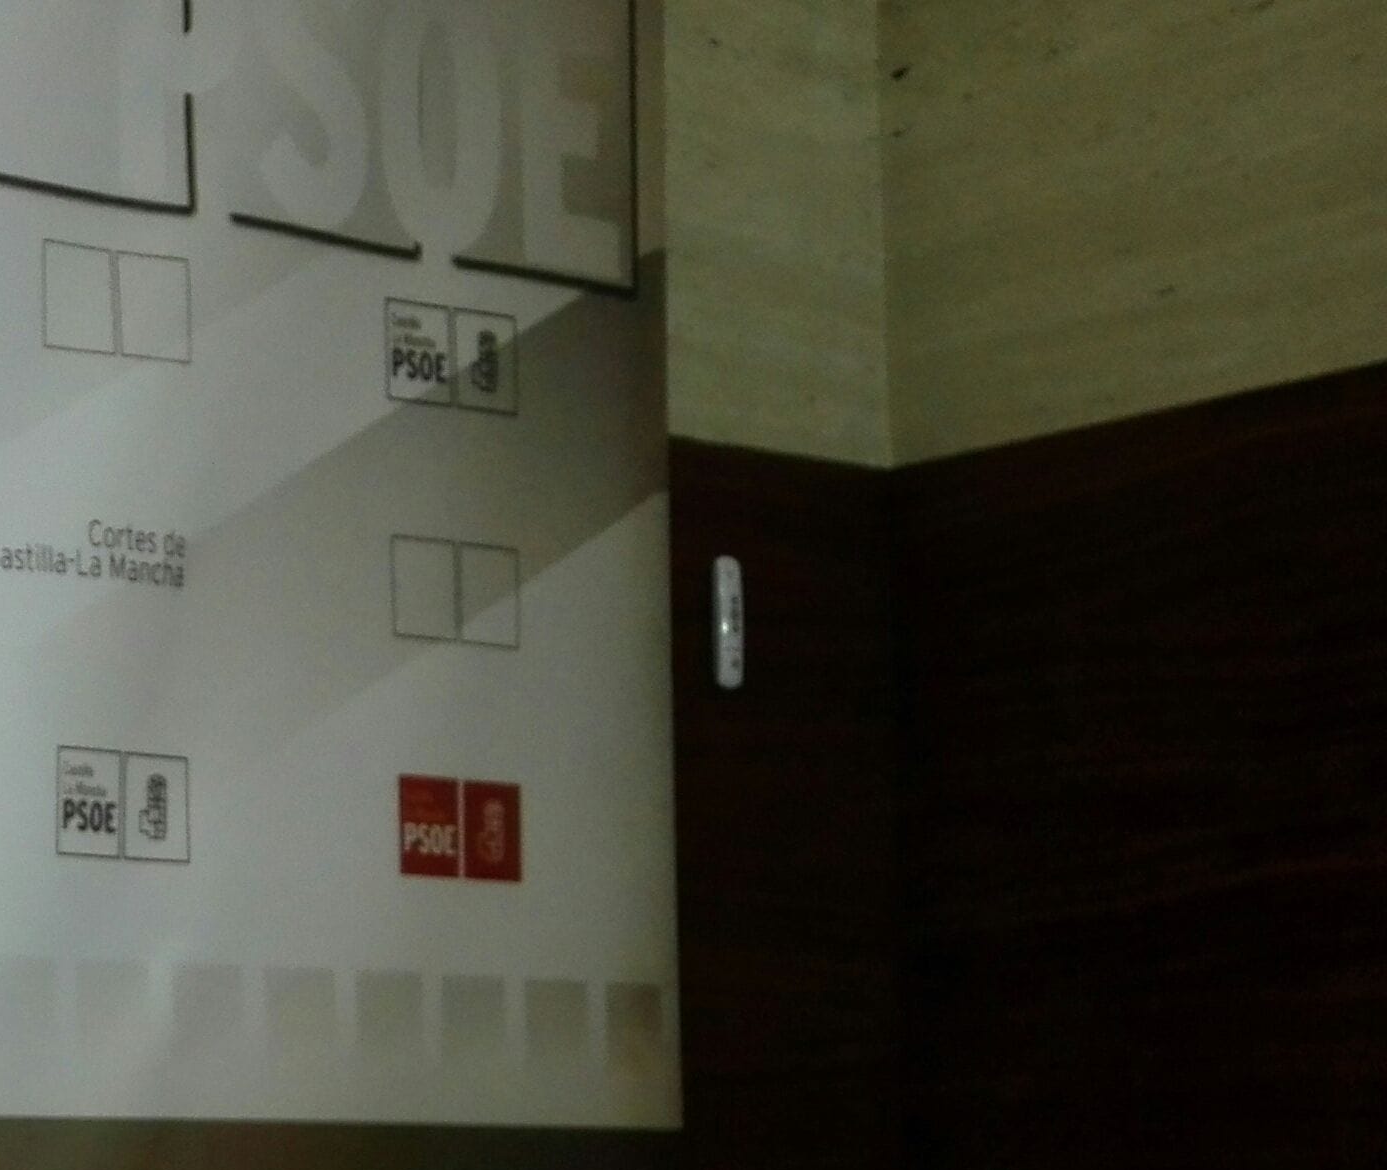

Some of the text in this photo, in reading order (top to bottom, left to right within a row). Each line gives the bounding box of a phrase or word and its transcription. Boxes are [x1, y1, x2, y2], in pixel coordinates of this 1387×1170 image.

[392, 347, 447, 384] PSOE
[88, 518, 186, 559] Cortes de
[109, 553, 184, 587] Mancha
[62, 799, 117, 834] PSOE
[403, 822, 457, 856] PSOE
